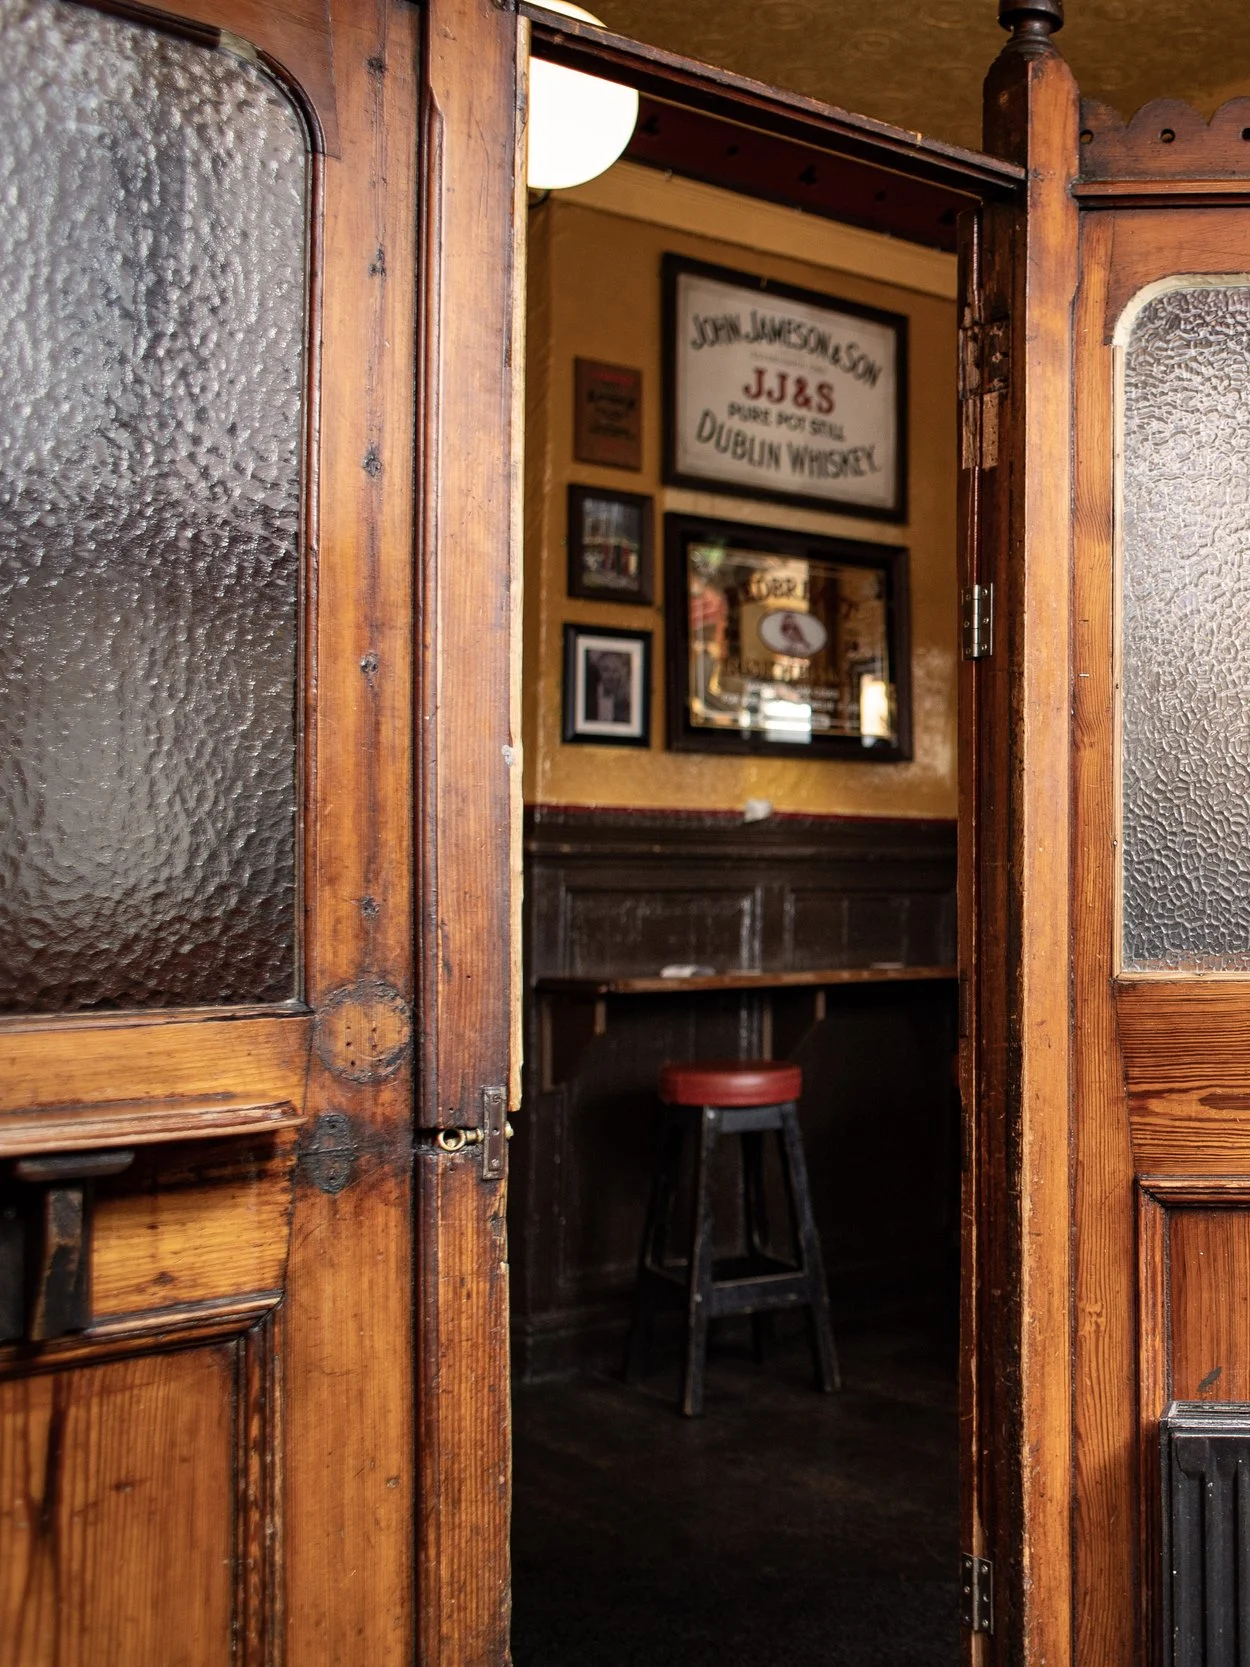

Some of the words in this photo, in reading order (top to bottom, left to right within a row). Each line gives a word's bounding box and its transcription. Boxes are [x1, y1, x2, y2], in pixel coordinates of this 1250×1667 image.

[691, 311, 741, 350] JOHN
[744, 308, 831, 358] JAMESON
[829, 342, 841, 367] &
[841, 341, 883, 389] SON
[742, 366, 835, 416] JJ&S
[695, 407, 782, 472] DUBLIN
[727, 401, 772, 427] PURE
[776, 410, 807, 432] POT
[809, 417, 846, 442] STILL
